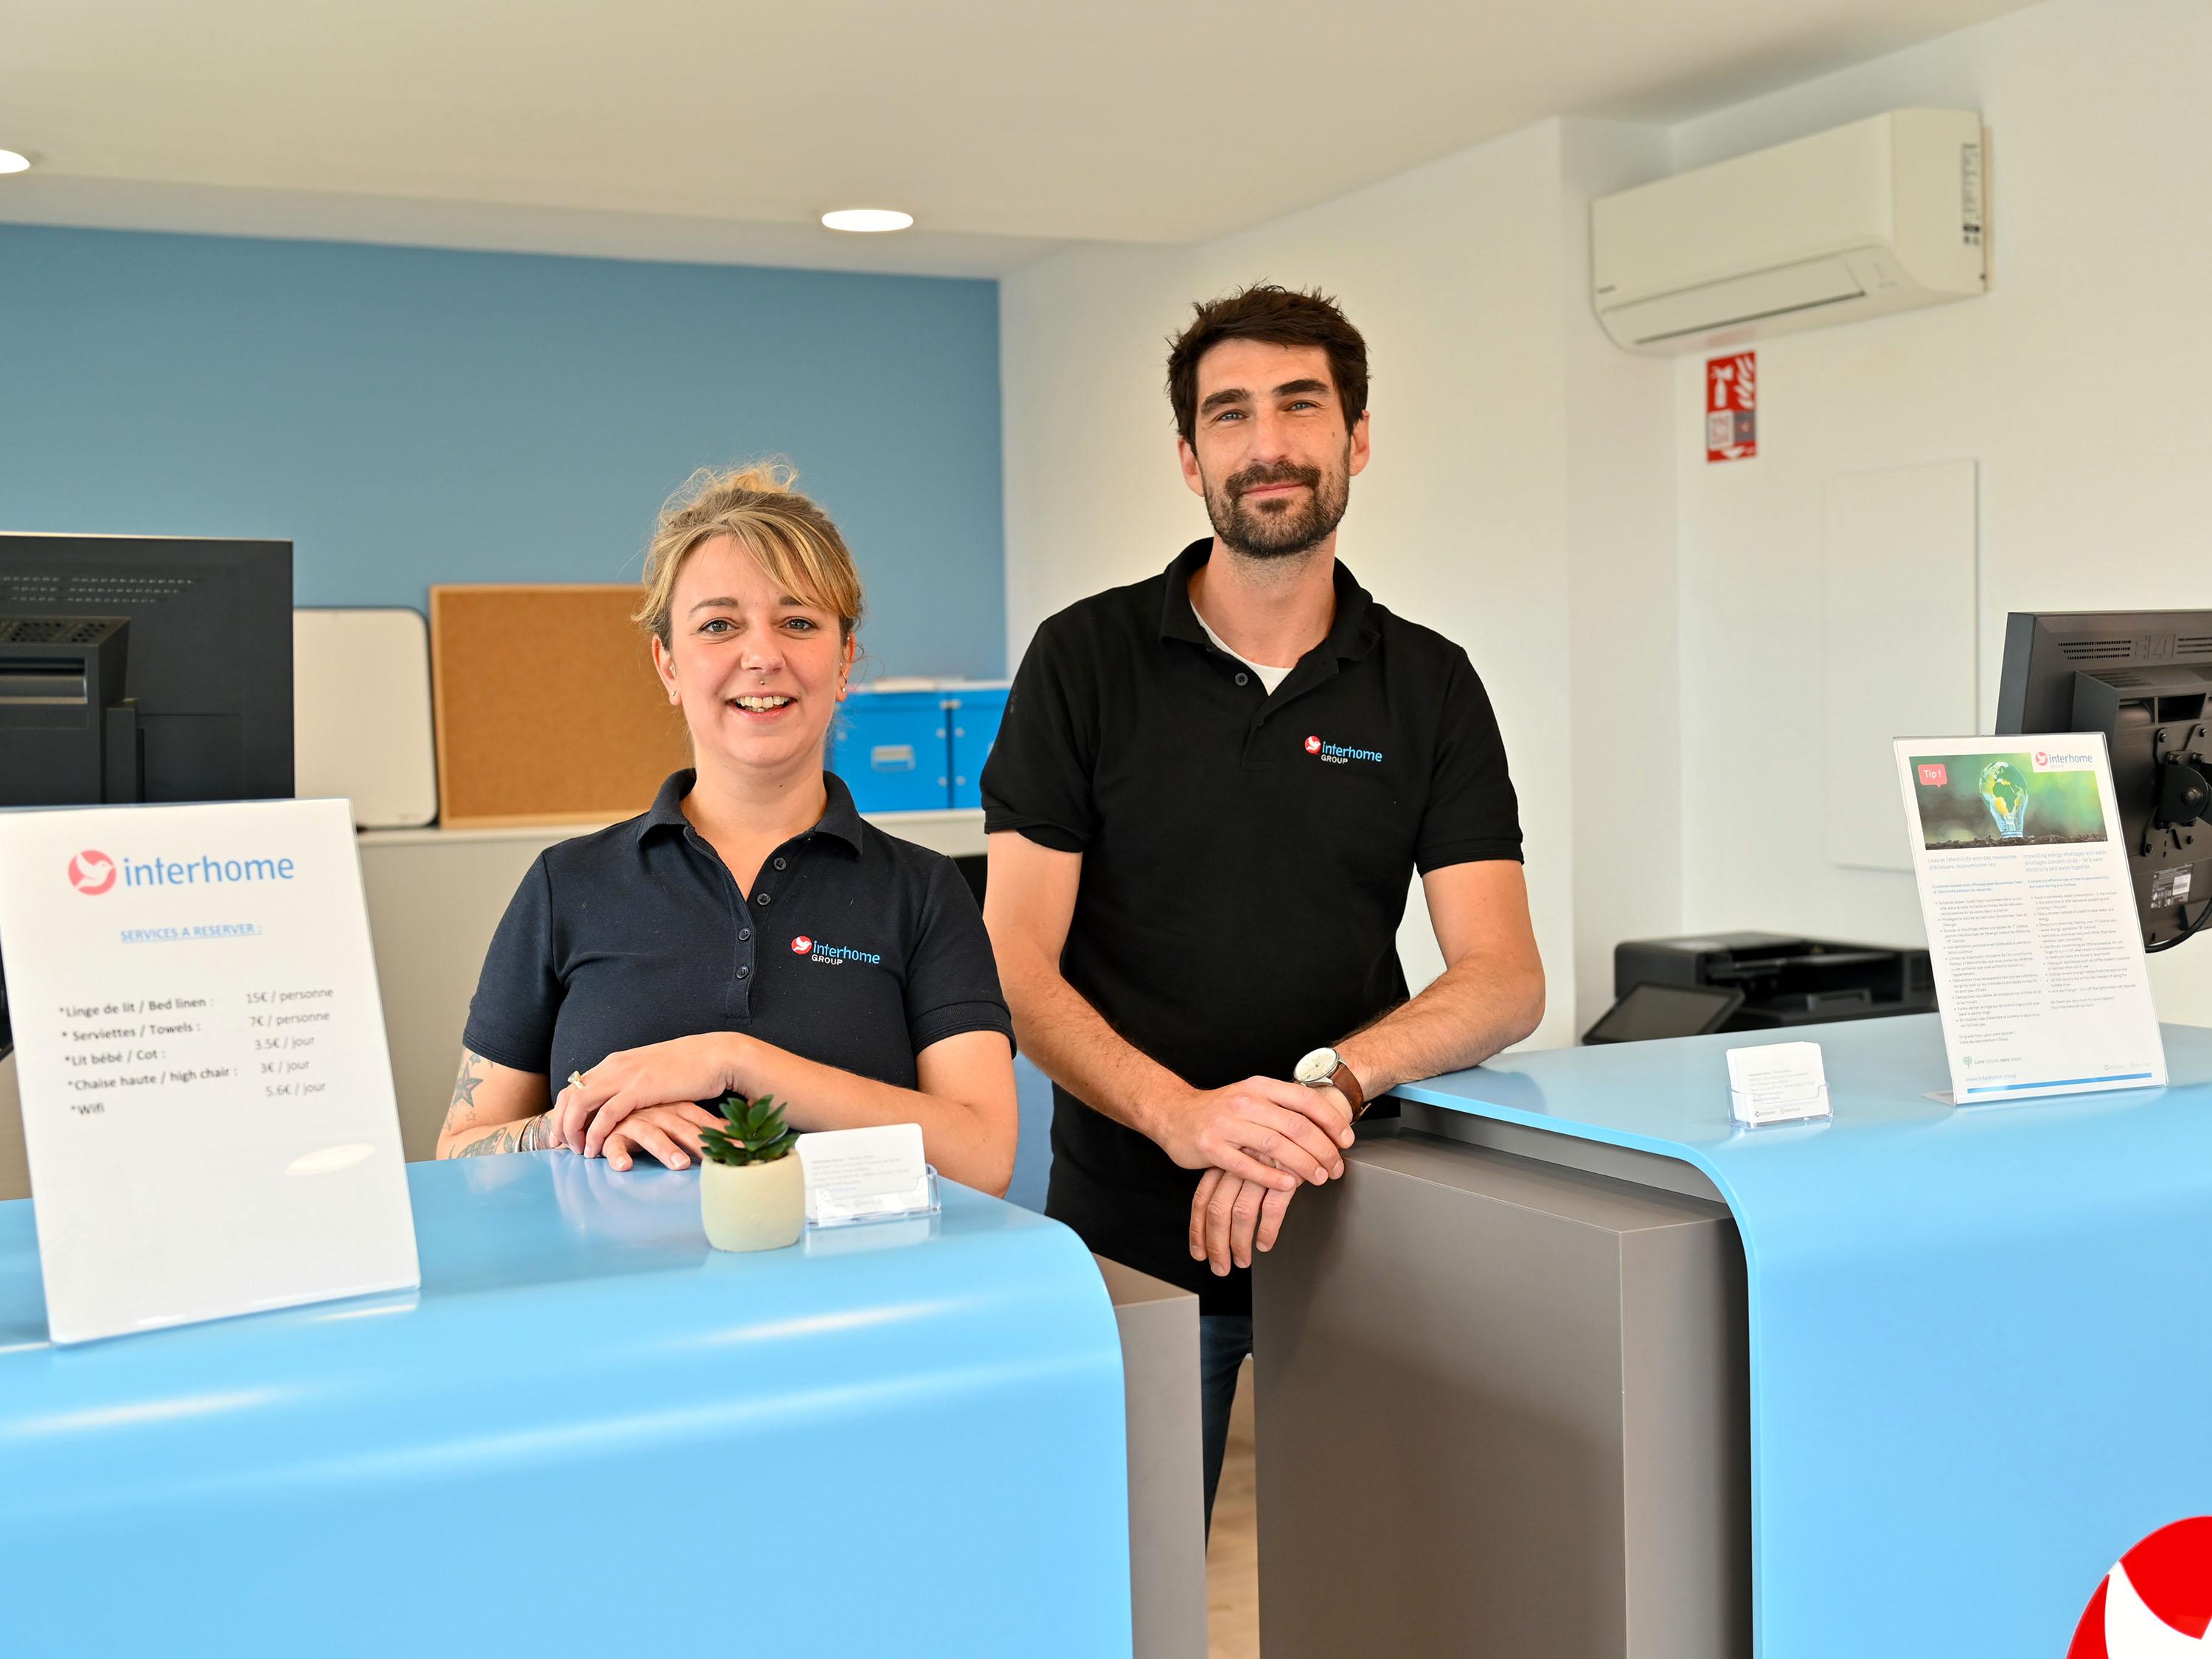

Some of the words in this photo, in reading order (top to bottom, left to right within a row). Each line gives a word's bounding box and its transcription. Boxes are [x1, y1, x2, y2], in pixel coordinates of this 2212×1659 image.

[1321, 754, 1348, 764] GROUP
[1322, 741, 1382, 762] interhome
[2049, 754, 2093, 763] interhome
[1924, 770, 1936, 779] Tip
[123, 855, 294, 886] interhome
[120, 928, 178, 942] SERVICES
[192, 923, 254, 936] RESERVER
[811, 954, 843, 965] GROUP
[813, 940, 880, 964] interhome
[246, 992, 268, 1004] 15€
[279, 989, 333, 1002] personne
[104, 1003, 118, 1015] de
[122, 1002, 135, 1012] lit
[148, 998, 172, 1011] Bed
[175, 998, 206, 1009] linen
[249, 1015, 265, 1026] 7€
[276, 1012, 330, 1026] personne
[73, 1028, 136, 1041] Serviettes
[150, 1021, 193, 1034] Towels
[254, 1037, 280, 1050] 3.5€
[291, 1036, 315, 1049] jour
[91, 1050, 122, 1065] bébé
[136, 1049, 158, 1060] Cot
[260, 1062, 275, 1074] 3€
[286, 1060, 310, 1074] jour
[120, 1073, 156, 1086] haute
[170, 1070, 196, 1083] high
[200, 1066, 229, 1079] chair
[265, 1084, 291, 1096] 5.6€
[303, 1082, 325, 1096] jour
